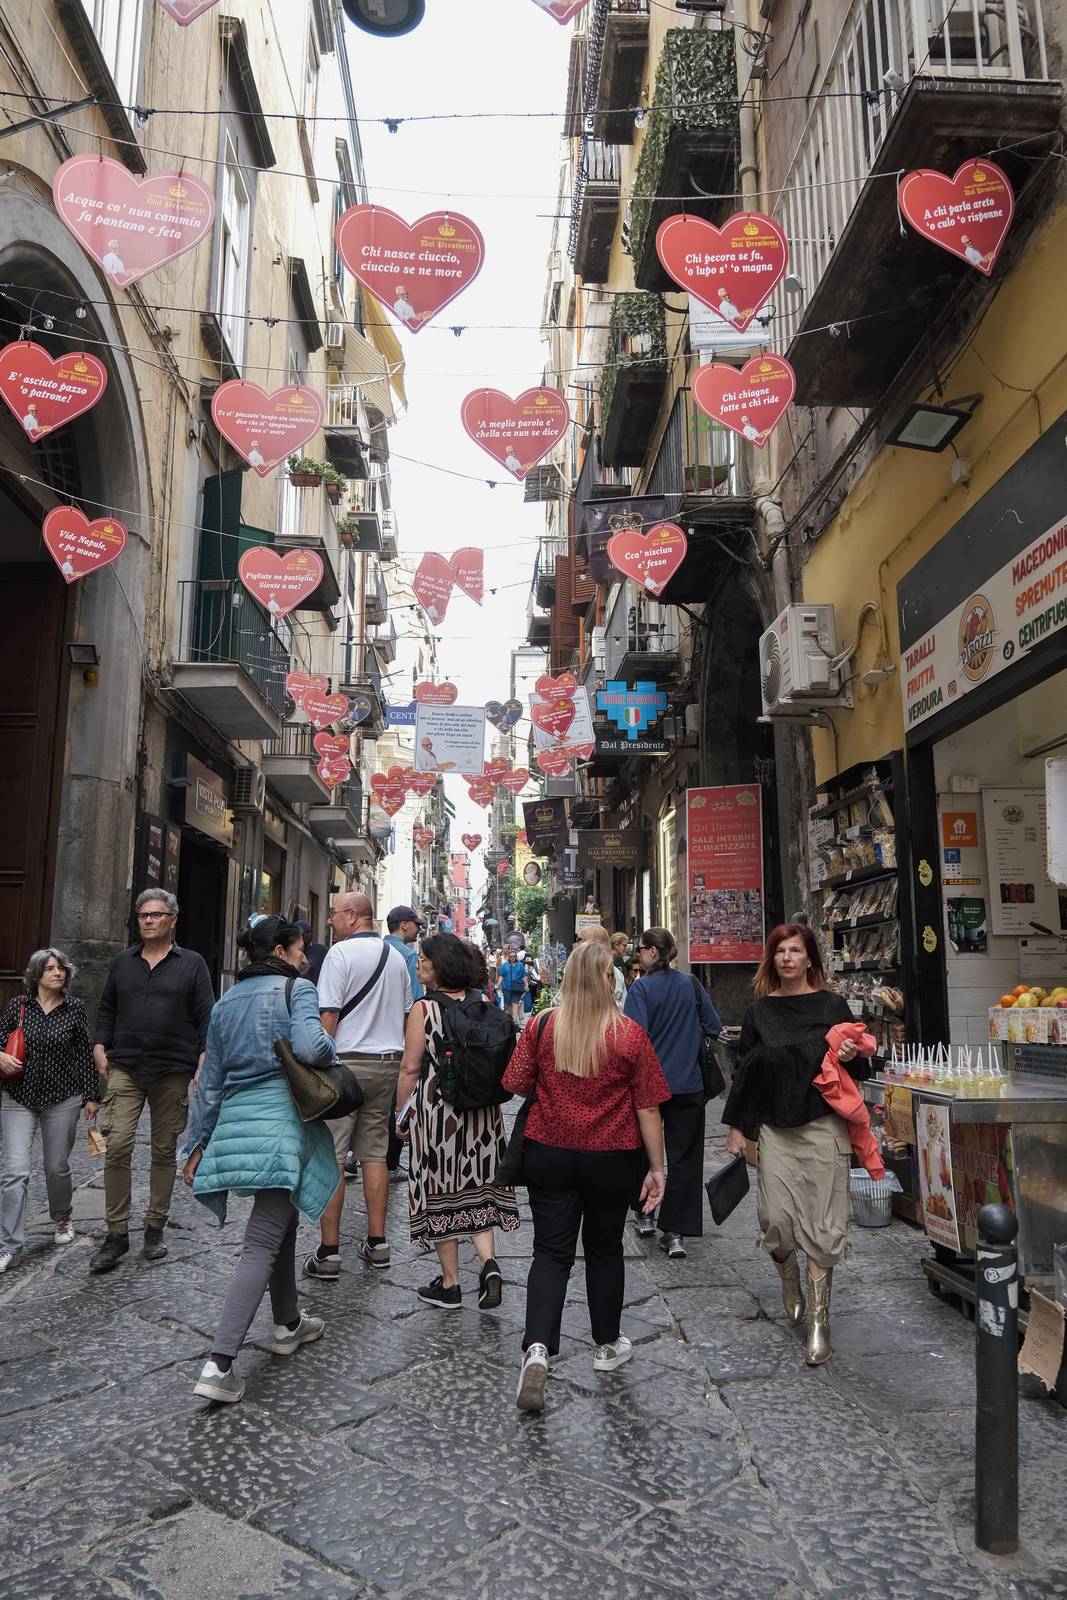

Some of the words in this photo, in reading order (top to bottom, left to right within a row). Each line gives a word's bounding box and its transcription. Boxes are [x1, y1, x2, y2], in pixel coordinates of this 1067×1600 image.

[64, 192, 104, 209] Acqua
[129, 208, 151, 218] nun
[155, 212, 201, 227] cammin
[924, 210, 932, 219] A
[934, 206, 947, 217] chi
[949, 202, 971, 216] parla
[974, 198, 994, 208] areto
[78, 211, 91, 222] fa
[94, 215, 144, 232] pantano
[148, 225, 154, 234] e
[156, 225, 182, 239] feta
[938, 217, 955, 229] culo
[967, 209, 1003, 222] risponne
[361, 246, 381, 256] Chi
[384, 250, 415, 260] nasce
[419, 251, 460, 264] ciuccio,
[686, 253, 701, 263] Chi
[705, 252, 735, 264] pecora
[738, 252, 748, 260] se
[750, 250, 763, 261] fa,
[361, 261, 400, 273] ciuccio
[403, 266, 415, 275] se
[418, 267, 431, 276] ne
[435, 268, 462, 278] more
[696, 266, 717, 276] lupo
[743, 263, 773, 273] magna
[23, 376, 57, 388] asciuto
[58, 383, 88, 395] pazzo
[29, 389, 72, 403] patrone!
[722, 392, 736, 402] Chi
[739, 388, 769, 399] chiagne
[720, 404, 739, 415] fotte
[749, 398, 761, 408] chi
[763, 395, 779, 405] ride
[489, 421, 515, 429] meglio
[518, 419, 544, 428] parola
[476, 430, 500, 438] chella
[542, 428, 559, 436] dice
[59, 530, 77, 541] Vide
[76, 548, 101, 559] muore
[644, 546, 672, 557] nisciun
[647, 559, 666, 569] fesso
[246, 572, 272, 580] Pigliate
[905, 635, 935, 672] TARALLI
[961, 631, 994, 664] PIROZZI
[907, 664, 935, 698] FRUTTA
[908, 686, 943, 723] VERDURA
[601, 741, 616, 749] Dal
[620, 741, 665, 750] Presidente
[692, 836, 714, 844] SALE
[718, 834, 756, 842] INTERNE
[692, 842, 757, 852] CLIMATIZZATE
